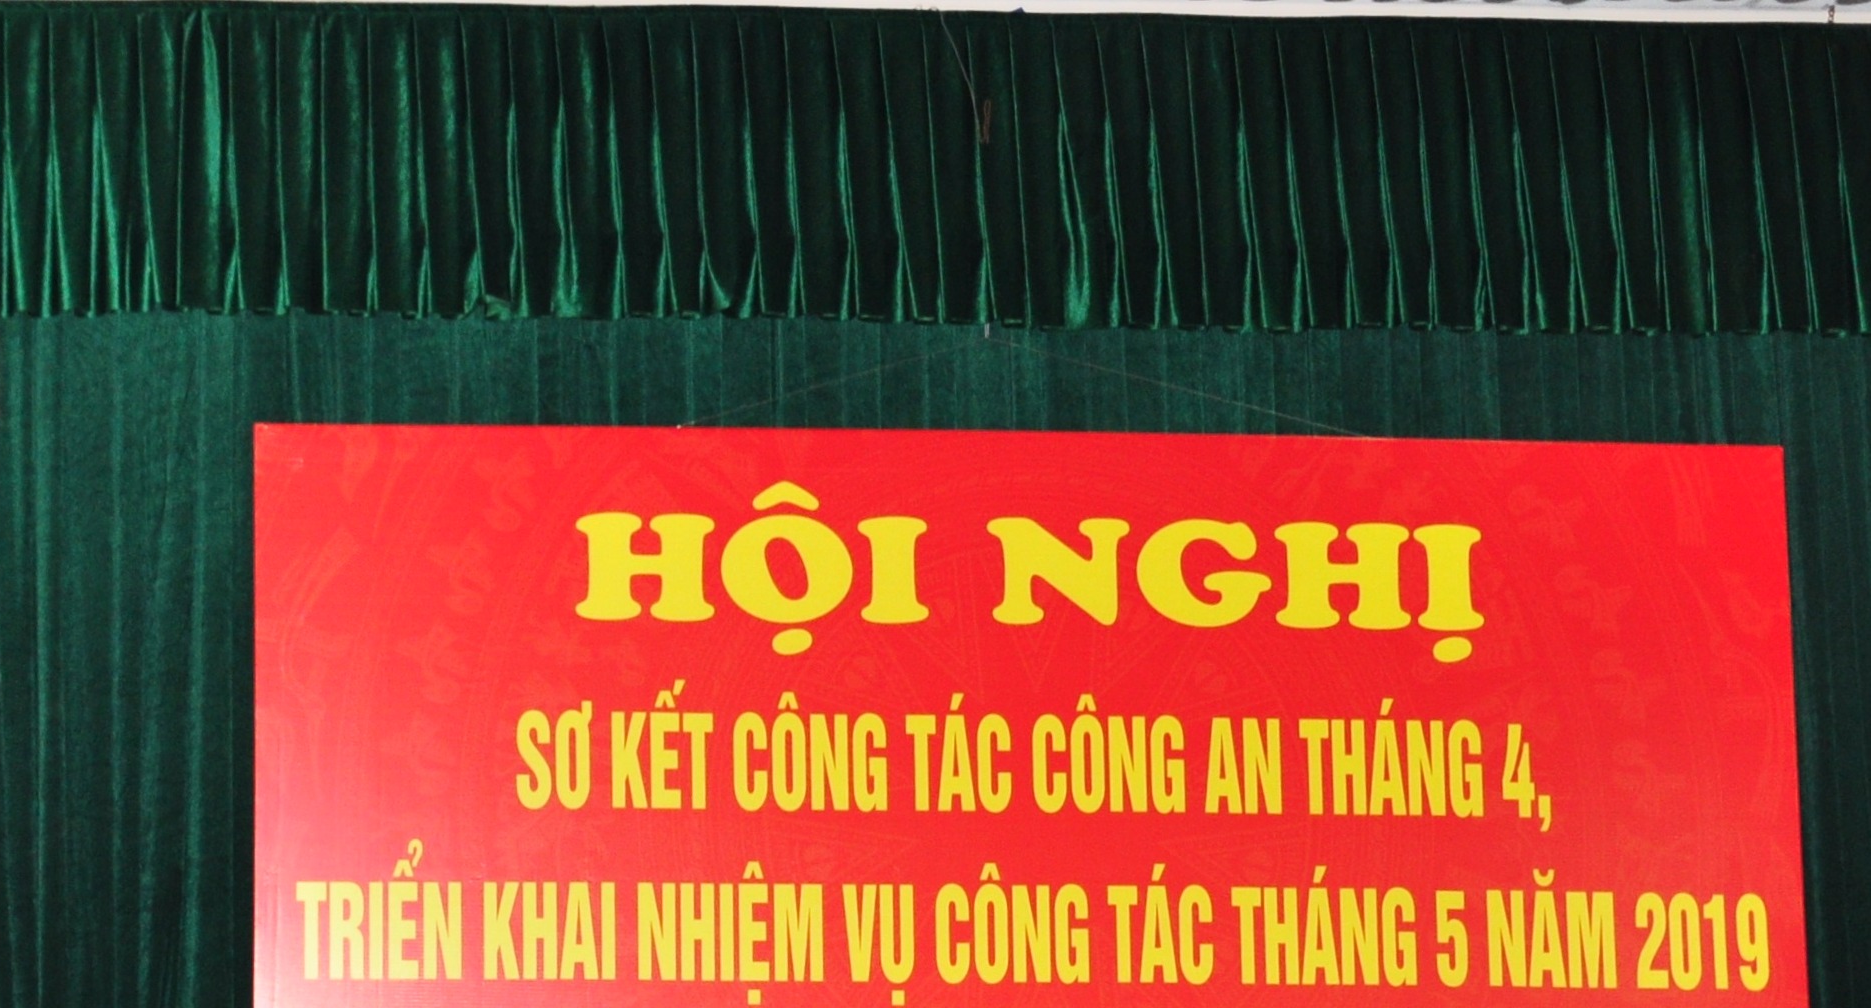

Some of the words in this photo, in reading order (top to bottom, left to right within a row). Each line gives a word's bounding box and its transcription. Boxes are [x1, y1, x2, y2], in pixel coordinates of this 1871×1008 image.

[576, 482, 929, 655] HỘI
[987, 518, 1484, 662] NGHỊ
[516, 701, 592, 809] SƠ
[611, 680, 713, 809] KẾT
[733, 692, 887, 812] CÔNG
[906, 694, 1011, 812] TÁC
[1033, 694, 1185, 813] CÔNG
[1206, 718, 1282, 814] AN
[1299, 699, 1483, 817] THÁNG
[1503, 724, 1551, 831] 4,
[297, 839, 463, 979] TRIỂN
[483, 881, 616, 980] KHAI
[638, 861, 823, 1005] NHIỆM
[843, 884, 914, 1006] VỤ
[936, 863, 1089, 984] CÔNG
[1108, 864, 1213, 984] TÁC
[1232, 866, 1417, 986] THÁNG
[1436, 891, 1468, 987] 5
[1487, 869, 1617, 988] NĂM
[1636, 892, 1769, 991] 2019
